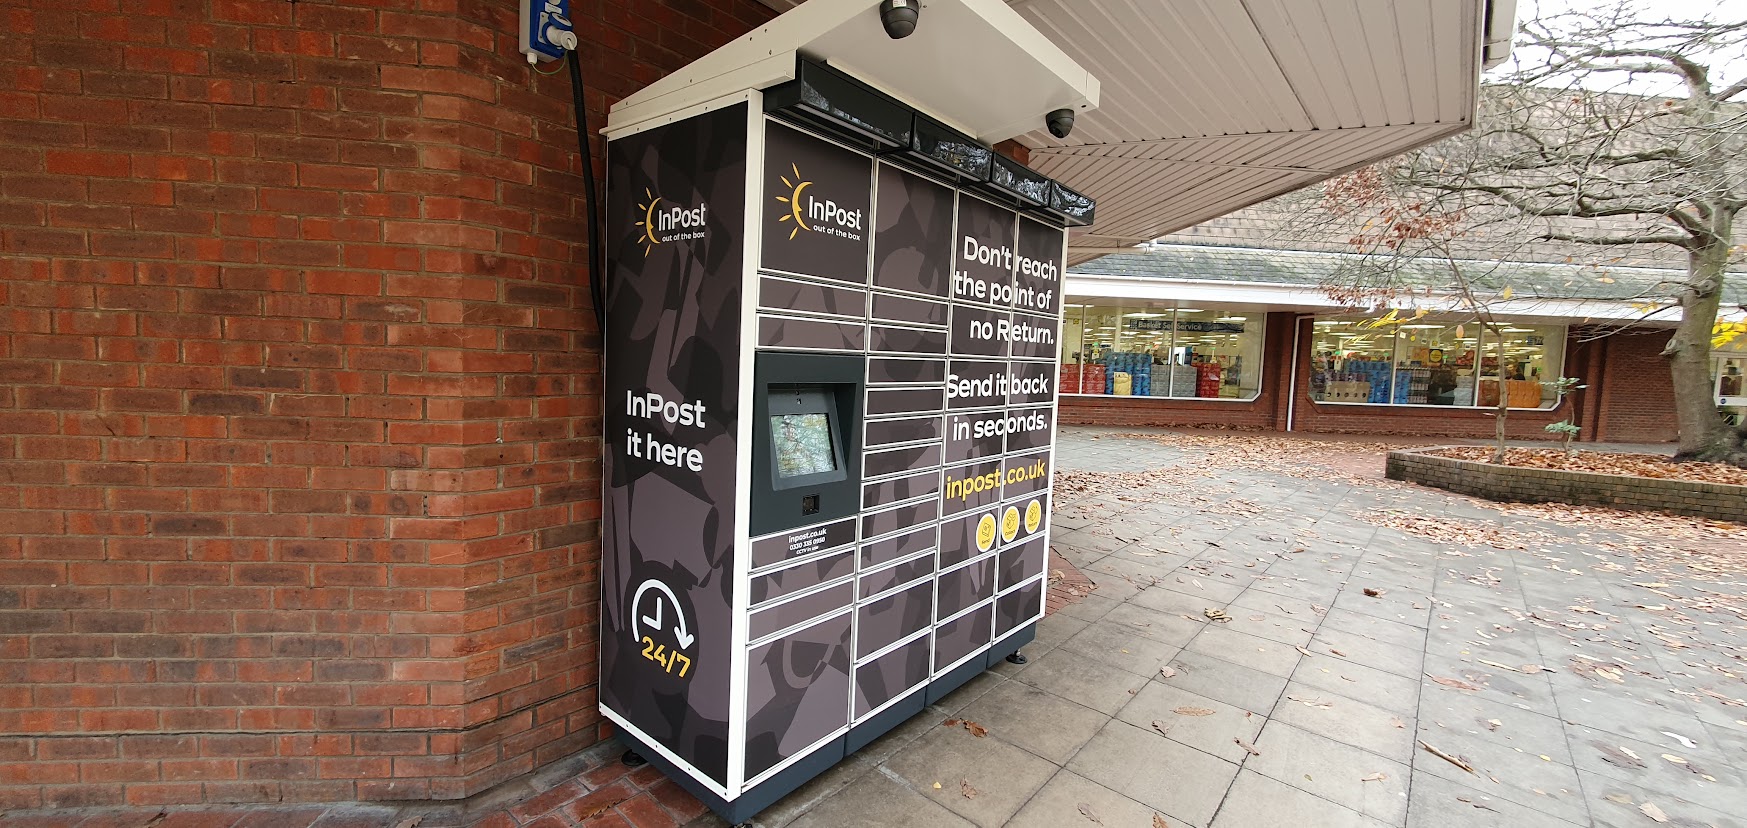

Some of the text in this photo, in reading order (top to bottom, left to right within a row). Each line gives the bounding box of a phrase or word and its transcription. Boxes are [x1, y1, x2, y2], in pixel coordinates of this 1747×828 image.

[658, 203, 706, 231] InPost
[809, 195, 861, 230] InPost
[662, 231, 705, 242] out of the box
[813, 225, 861, 241] out of the box
[963, 235, 1058, 281] Don't reach
[954, 271, 1052, 309] the point of
[970, 319, 1054, 344] no Return.
[948, 373, 993, 398] Send
[996, 373, 1007, 396] it
[1010, 373, 1049, 395] back
[627, 390, 706, 428] InPost
[953, 410, 1048, 441] in seconds.
[627, 428, 703, 472] it here
[946, 459, 1046, 501] inpost.co.uk
[788, 528, 827, 543] inpost.co.uk
[641, 636, 691, 678] 24/7
